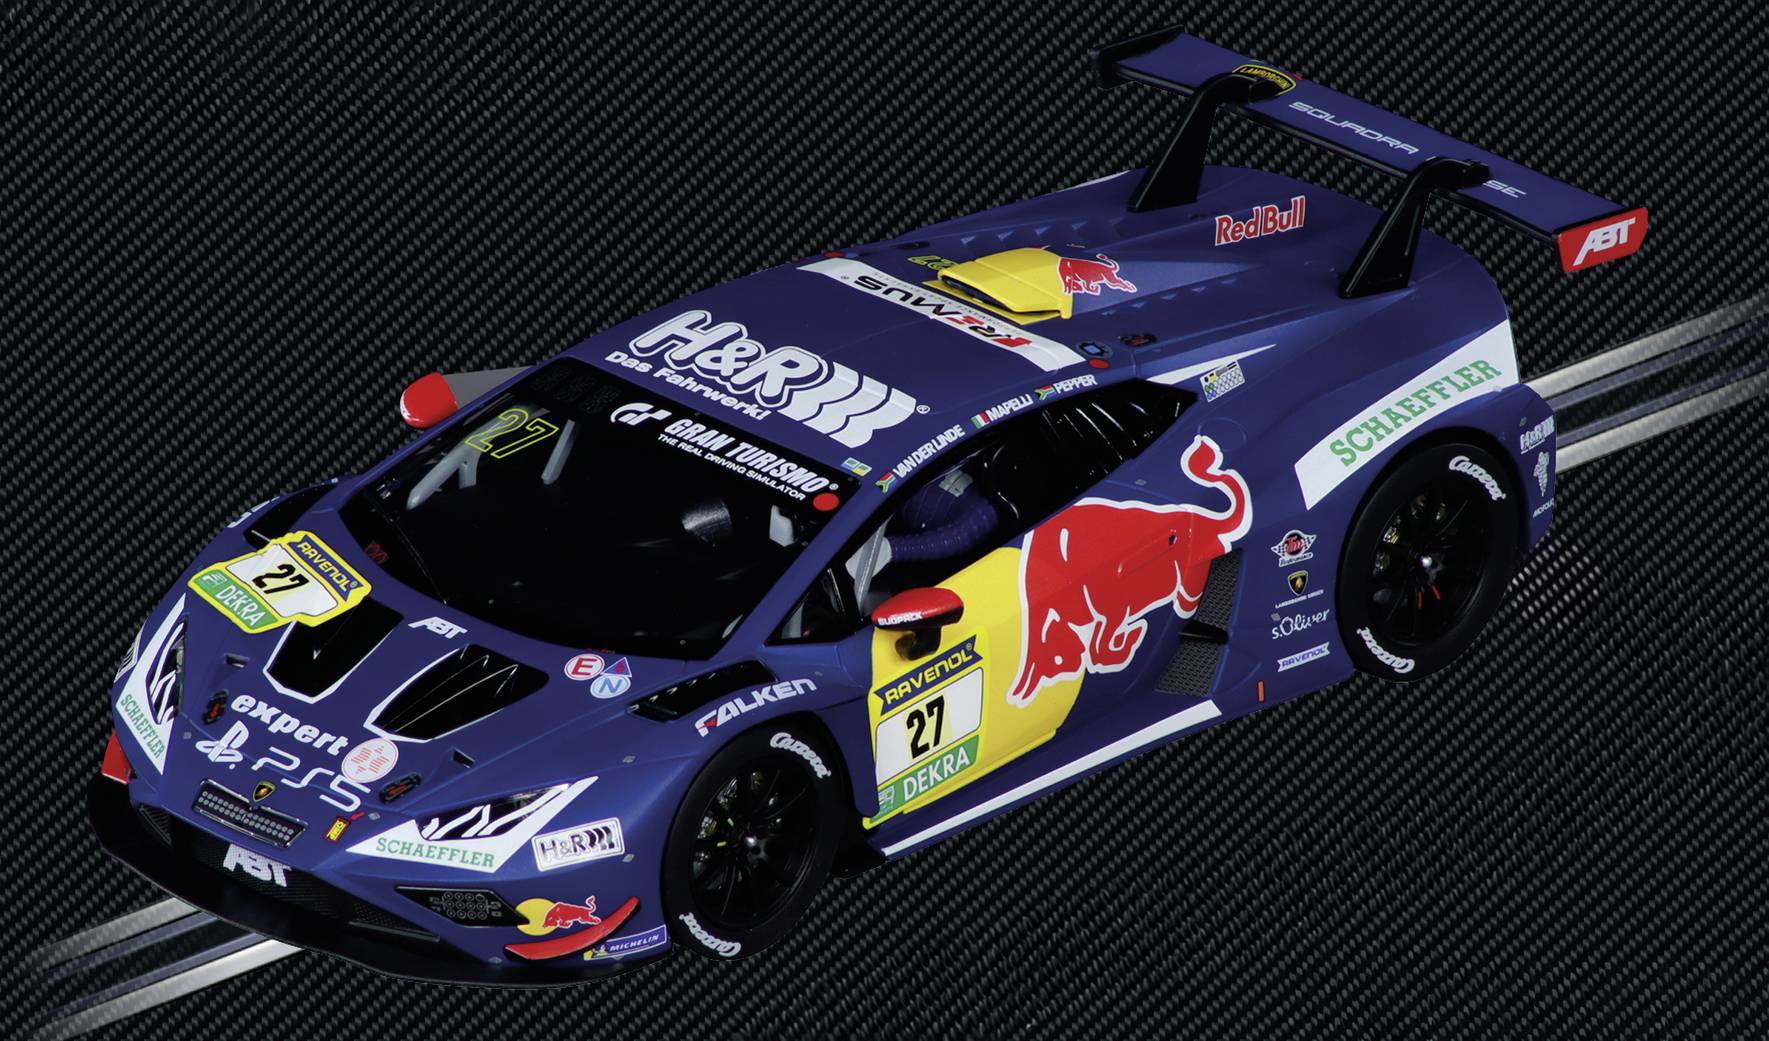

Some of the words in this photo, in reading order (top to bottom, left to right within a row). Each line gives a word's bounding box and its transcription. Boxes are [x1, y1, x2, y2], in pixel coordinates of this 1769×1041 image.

[1288, 101, 1420, 154] SQUADRA
[1215, 206, 1261, 246] Red
[1261, 194, 1306, 236] Bull
[1573, 216, 1636, 266] ABT
[854, 275, 1016, 341] REMUS
[605, 351, 651, 374] Das
[1053, 374, 1098, 395] PEPPER
[986, 394, 1034, 421] MAPELLI
[1329, 360, 1502, 467] SCHAEFFLER
[465, 408, 559, 459] 27
[664, 419, 735, 451] GRAN
[892, 455, 917, 478] VAN
[912, 440, 936, 466] DER
[931, 424, 965, 451] LINDE
[658, 433, 677, 447] THE
[677, 441, 702, 458] REAL
[704, 453, 747, 475] DRIVING
[746, 469, 806, 501] SIMULATOR
[252, 564, 309, 594] 27
[297, 542, 353, 591] RAVENOL
[215, 586, 266, 628] DEKRA
[407, 616, 468, 639] ABT
[1271, 609, 1330, 639] s.Oliver
[885, 649, 973, 705] RAVENOL
[1281, 647, 1326, 668] RAVENOL
[120, 694, 165, 758] SCHAEFFLER
[231, 694, 349, 756] expert
[694, 678, 817, 737] FALKEN
[906, 695, 945, 759] 27
[251, 746, 371, 812] PS5
[770, 732, 829, 779] Carrera
[903, 746, 970, 801] DEKRA
[223, 844, 292, 887] ABT
[376, 837, 495, 868] SCHAEFFLER
[609, 934, 659, 952] MICHELIN
